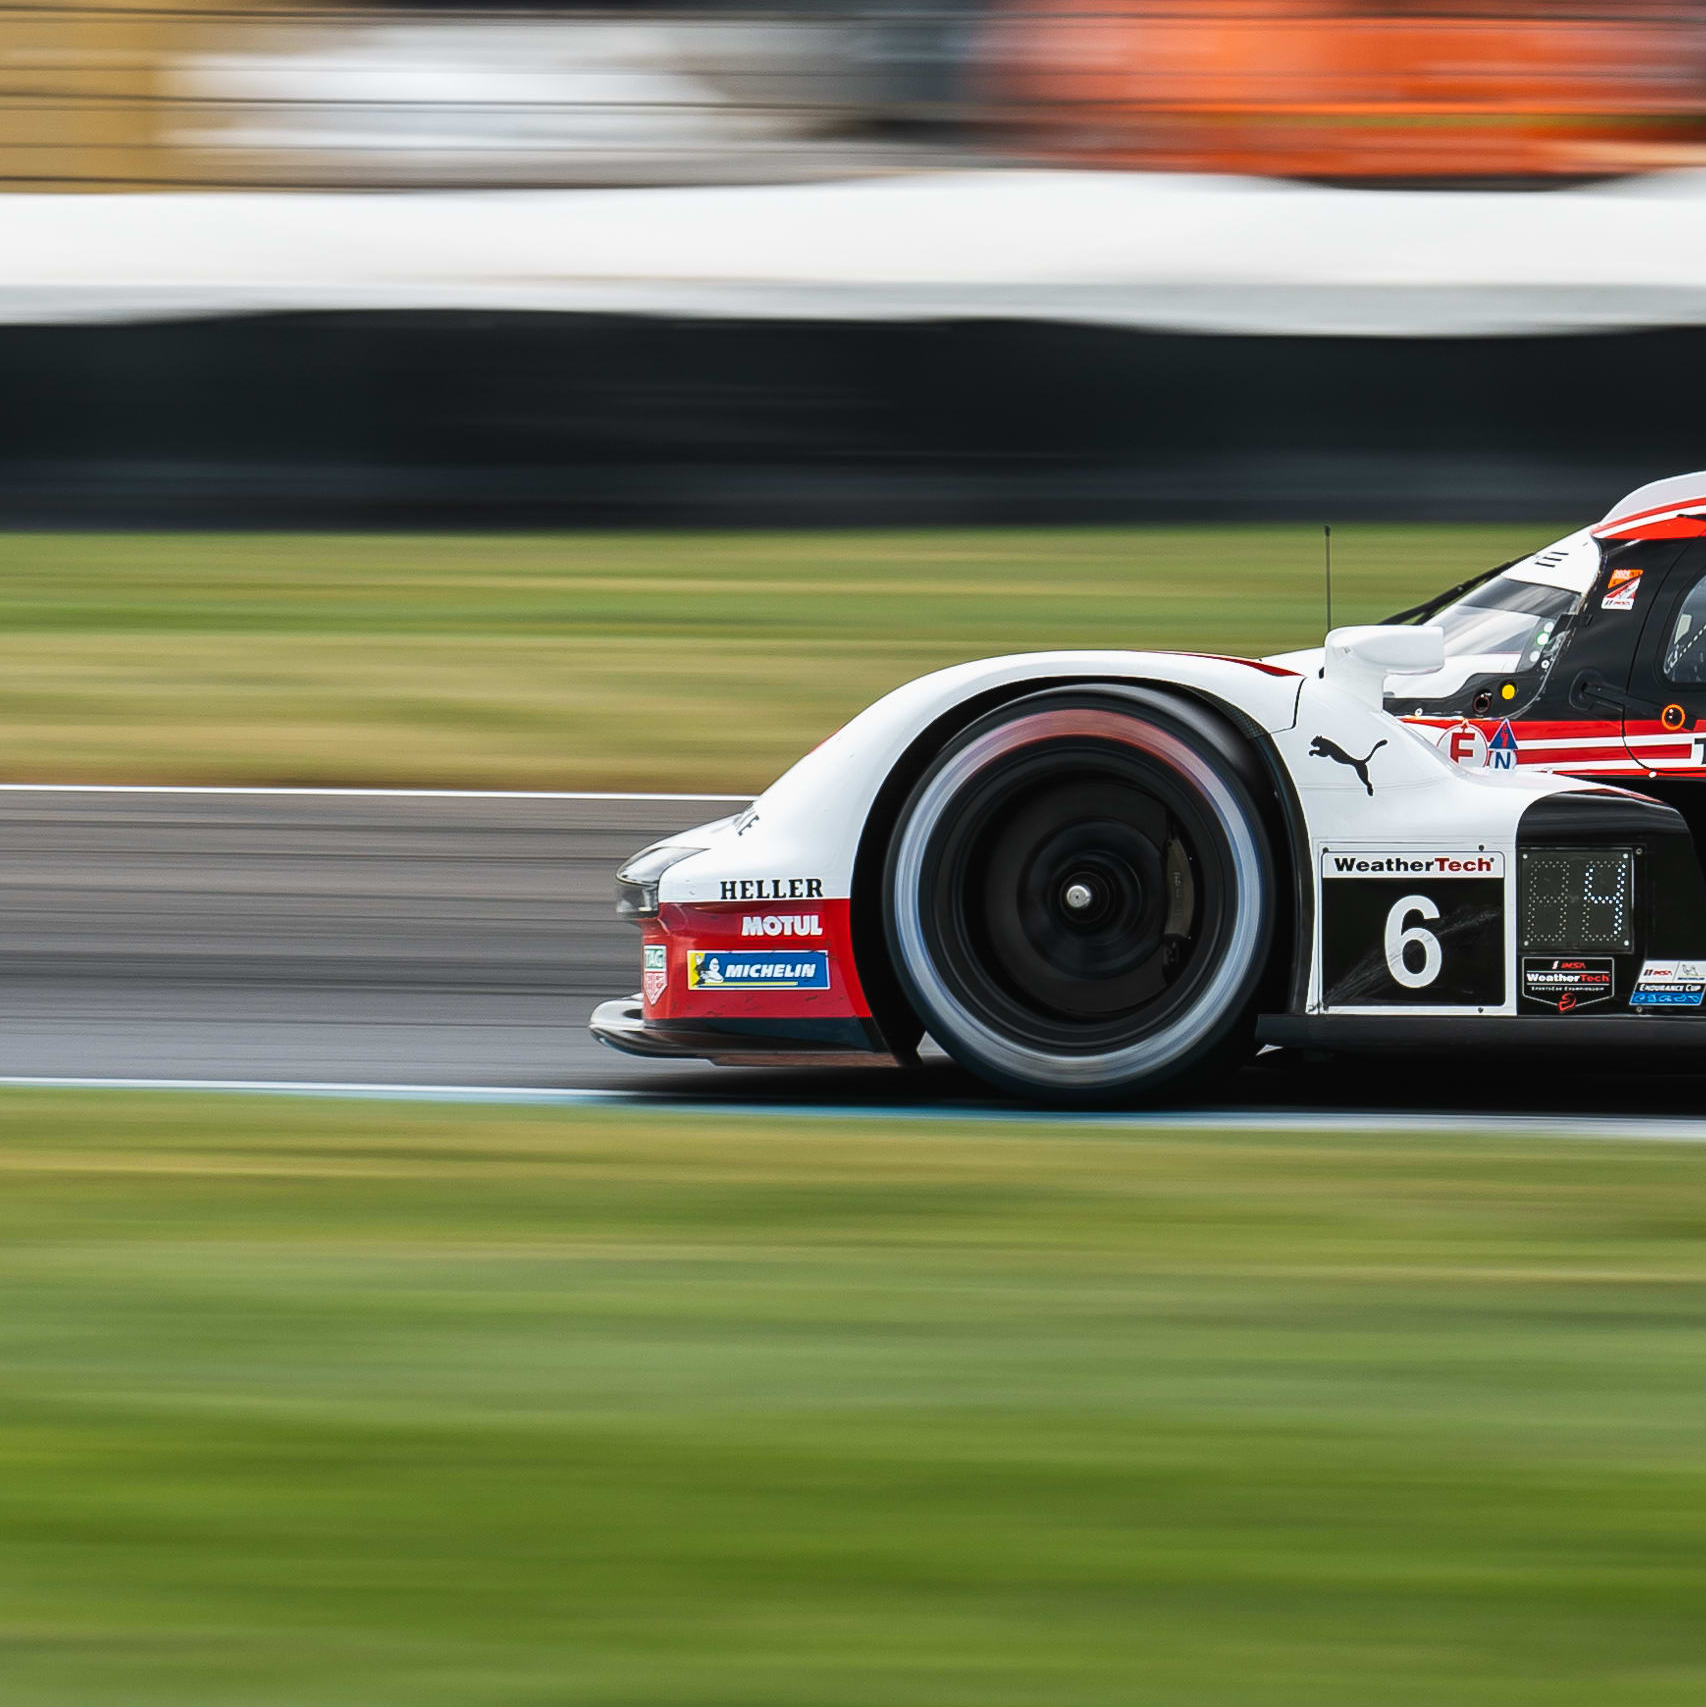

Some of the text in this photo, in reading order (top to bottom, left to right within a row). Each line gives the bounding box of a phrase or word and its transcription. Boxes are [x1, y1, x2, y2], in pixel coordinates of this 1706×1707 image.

[1495, 752, 1511, 769] N
[1334, 857, 1491, 872] WeatherTech
[720, 878, 823, 900] HELLER
[741, 915, 823, 936] MOTUL
[1384, 894, 1442, 989] 6
[724, 963, 816, 978] MICHELIN
[1526, 974, 1610, 982] WeatherTech
